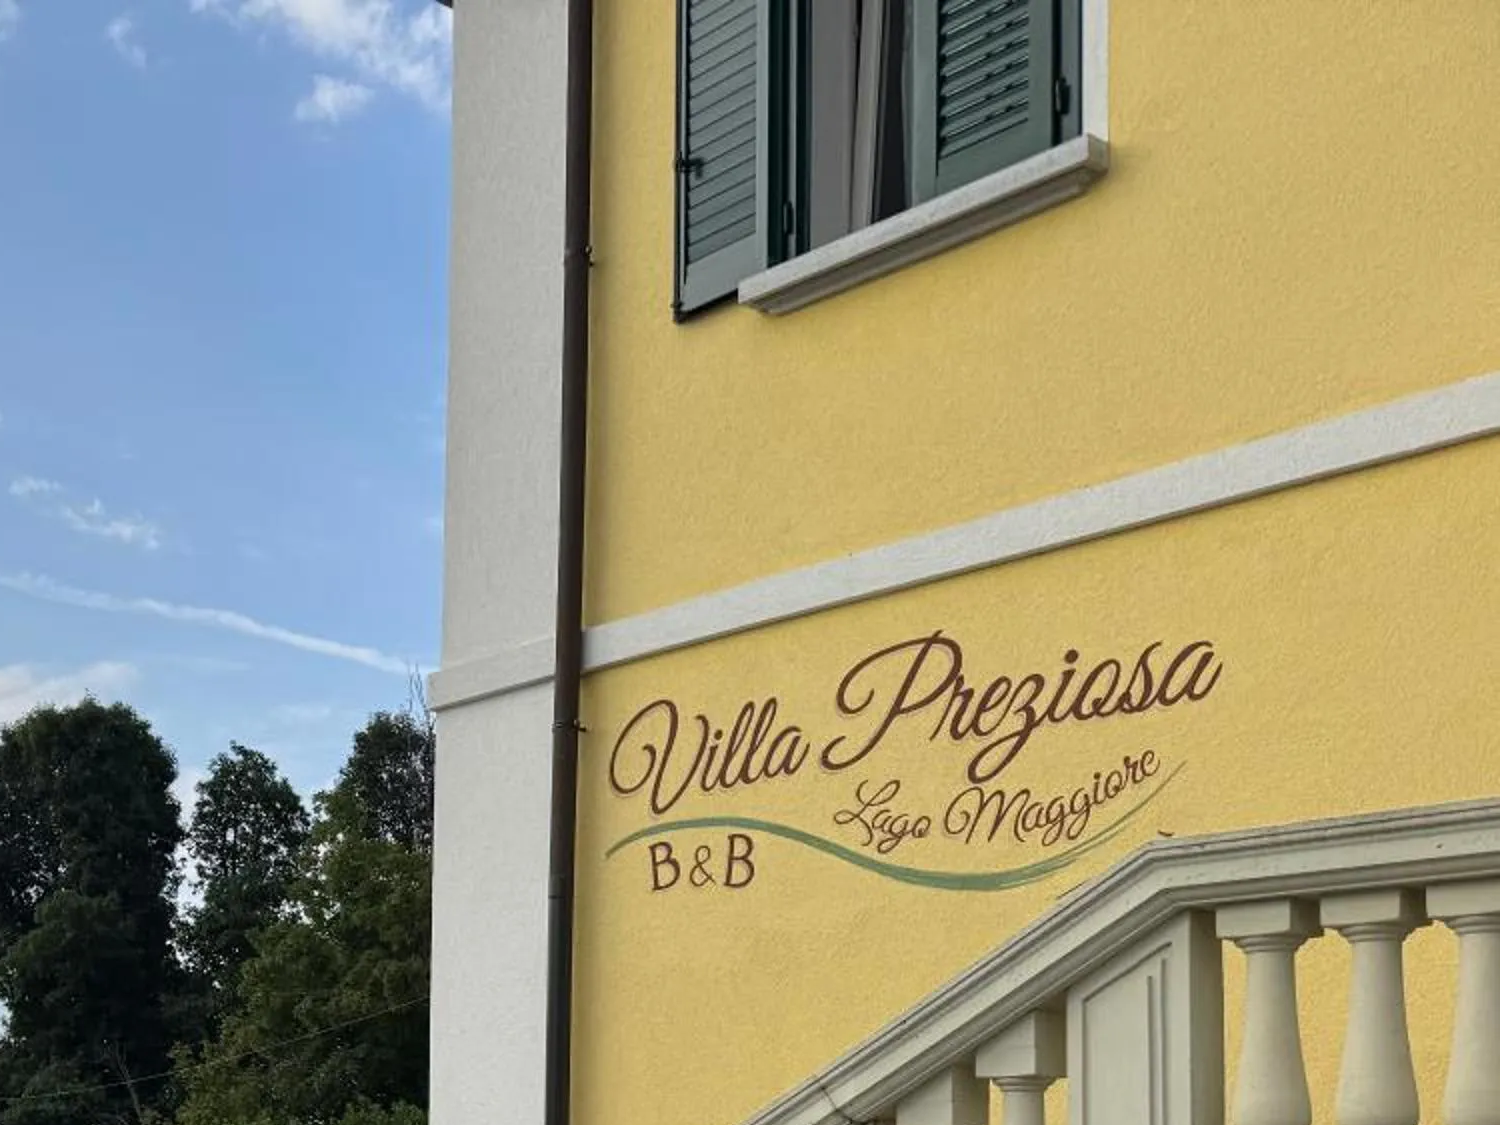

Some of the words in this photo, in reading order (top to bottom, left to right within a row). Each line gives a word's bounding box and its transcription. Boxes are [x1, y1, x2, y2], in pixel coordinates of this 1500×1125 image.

[610, 697, 810, 814] Villa
[820, 628, 1223, 784] Preziosa
[833, 780, 931, 854] Lago
[943, 748, 1160, 847] Maggiore
